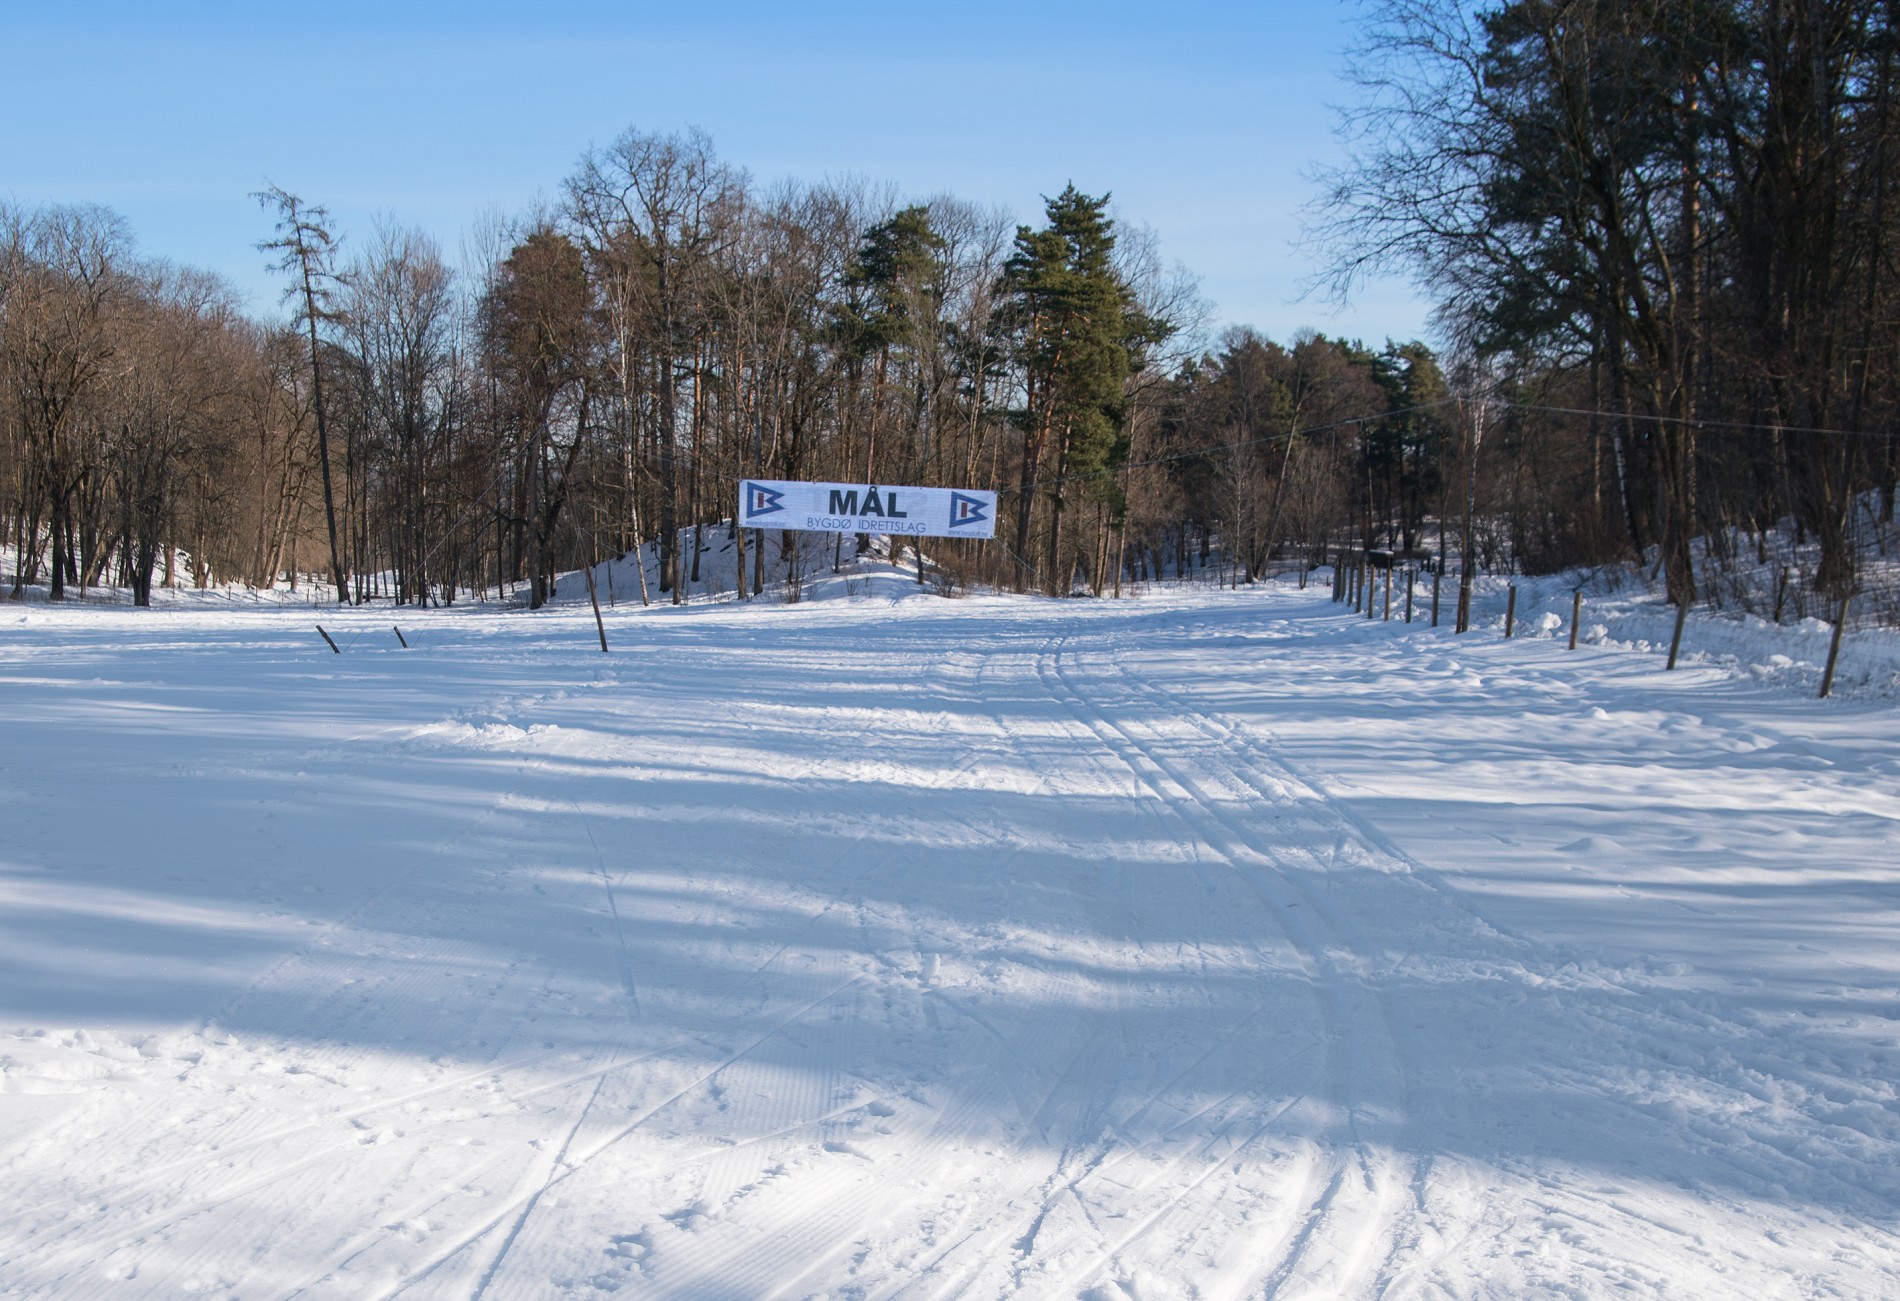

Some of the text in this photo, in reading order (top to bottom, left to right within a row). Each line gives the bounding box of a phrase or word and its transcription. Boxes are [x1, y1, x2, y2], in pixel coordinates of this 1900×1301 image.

[829, 486, 907, 518] MÅL
[807, 517, 926, 533] BYGDØ IDRETTSLAG
